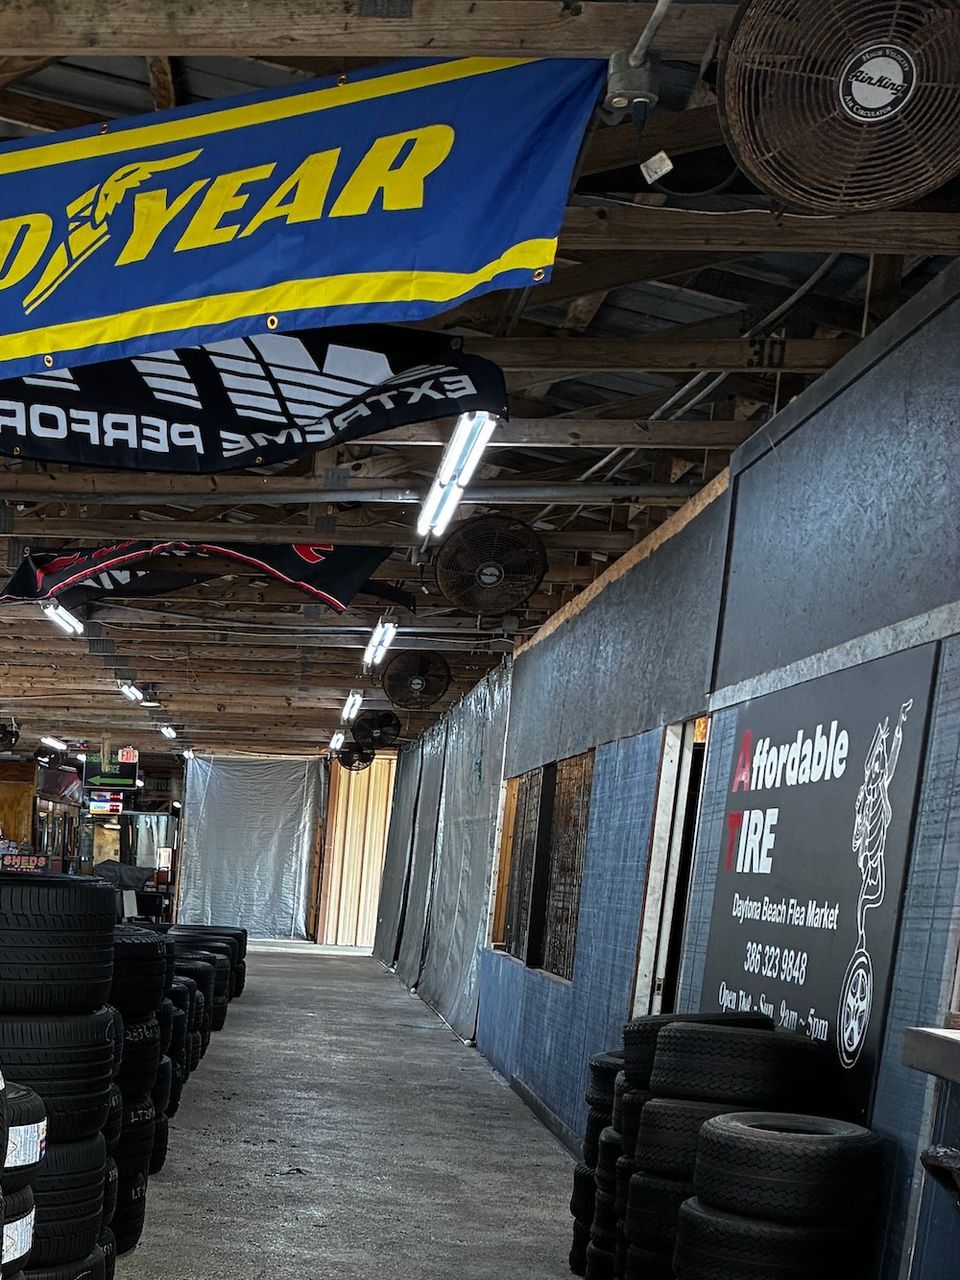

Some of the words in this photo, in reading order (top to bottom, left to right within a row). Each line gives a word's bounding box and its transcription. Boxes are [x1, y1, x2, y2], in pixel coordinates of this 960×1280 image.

[731, 720, 849, 793] Affordable
[3, 854, 47, 867] SHEDS
[725, 807, 779, 875] TIRE
[732, 892, 762, 924] Daytona
[761, 896, 787, 924] Beach
[786, 898, 806, 926] Flea
[805, 899, 840, 930] Market
[744, 940, 762, 974] 386
[762, 944, 781, 979] 323
[780, 948, 808, 986] 9848
[719, 981, 737, 1013] Open
[759, 993, 774, 1018] Sun
[779, 999, 798, 1031] 9am
[806, 1007, 829, 1041] 5pm
